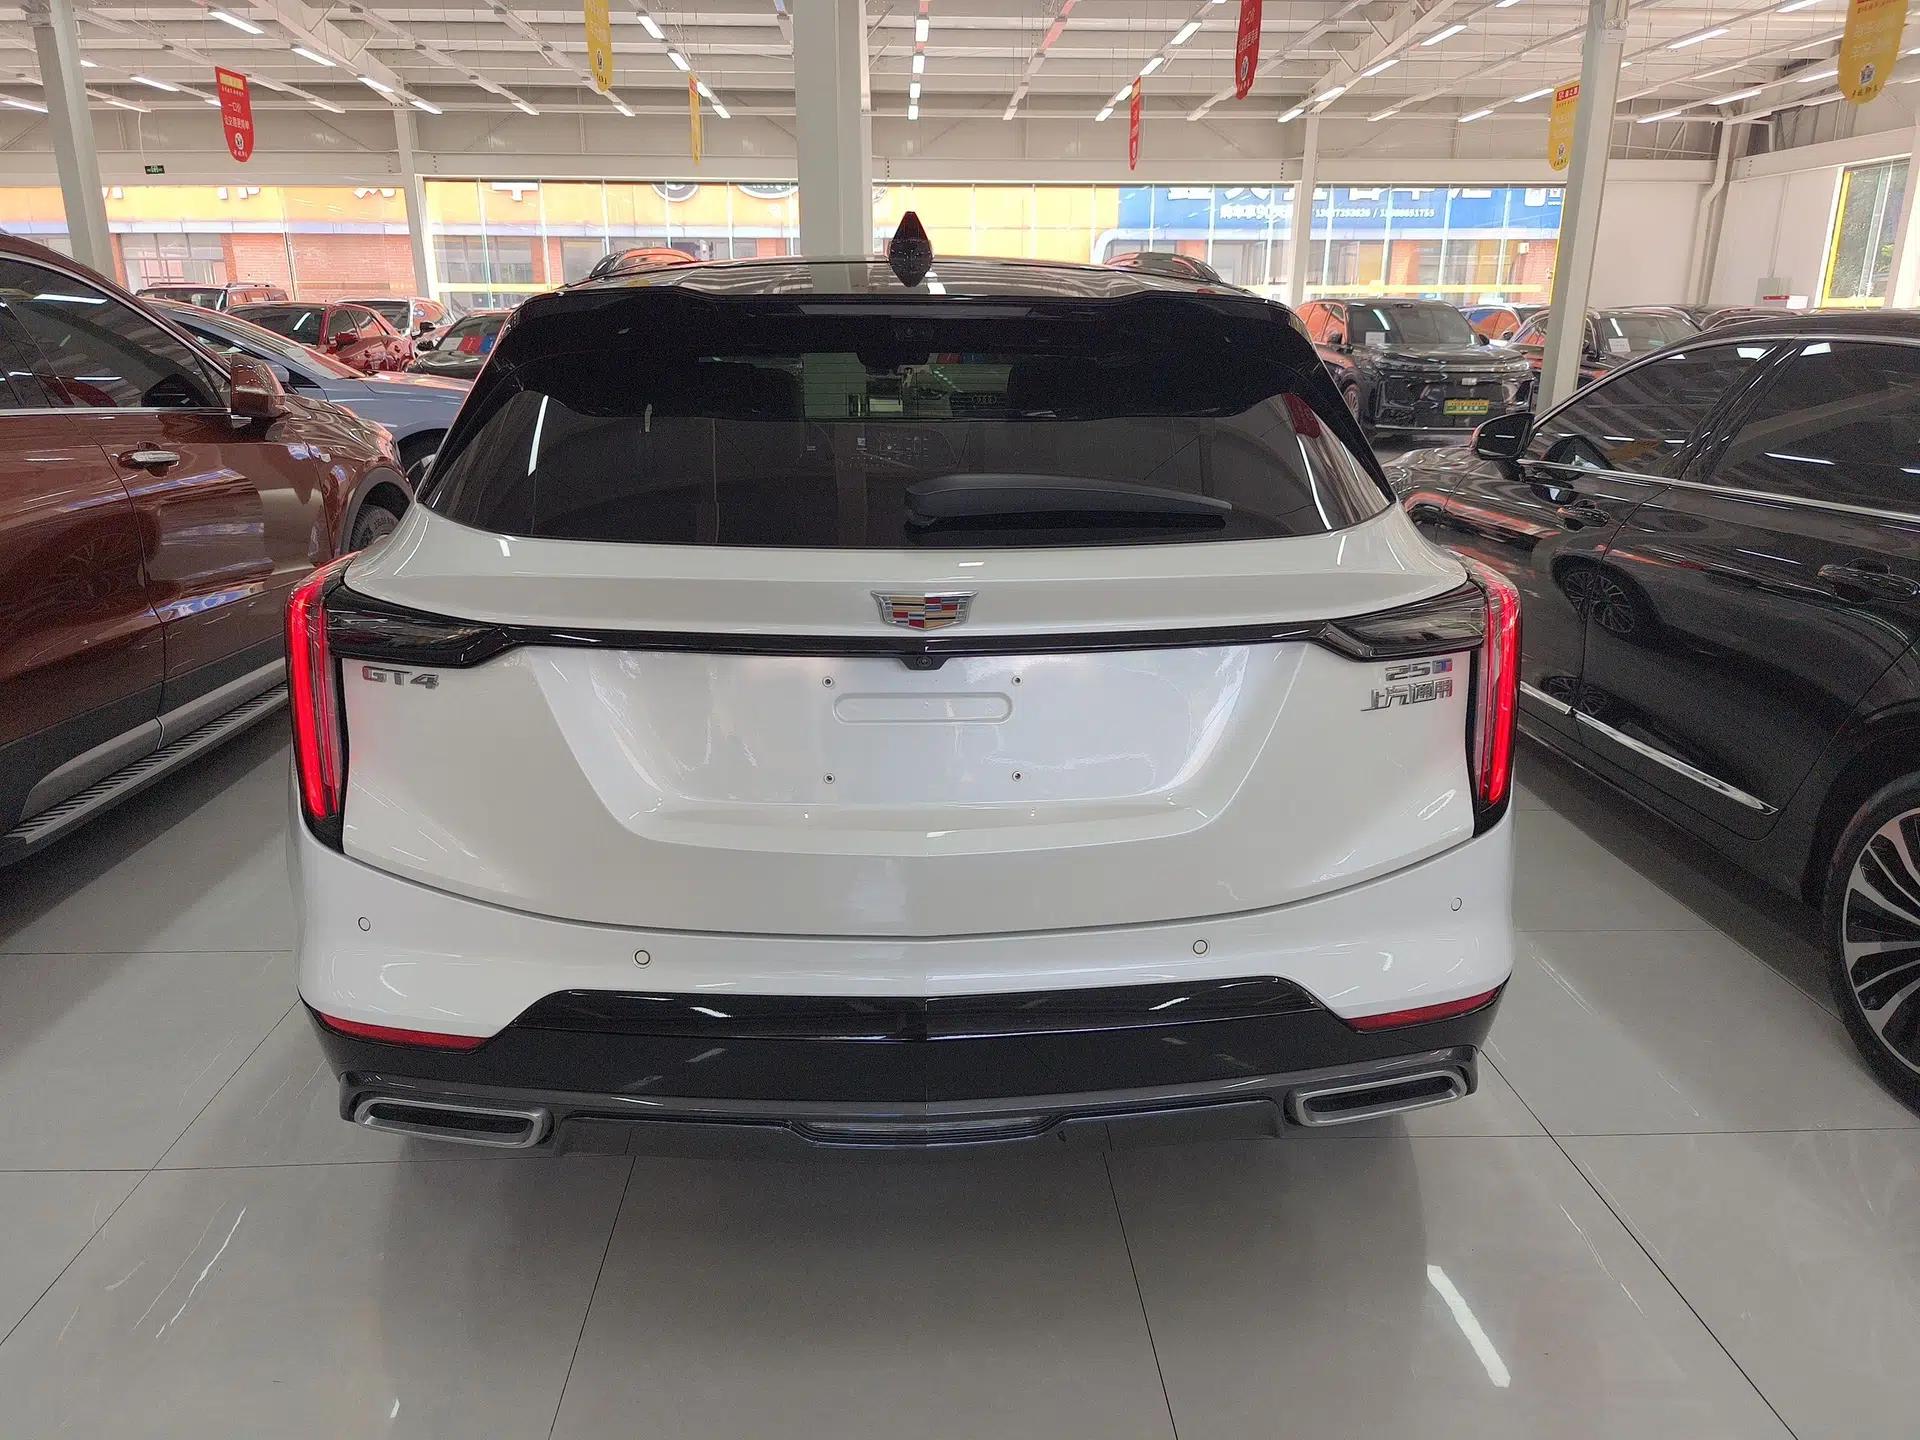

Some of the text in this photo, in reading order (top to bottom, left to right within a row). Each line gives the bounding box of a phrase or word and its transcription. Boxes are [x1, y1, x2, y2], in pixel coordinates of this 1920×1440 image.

[362, 665, 440, 690] GT4
[1360, 675, 1453, 712] 上汽通用
